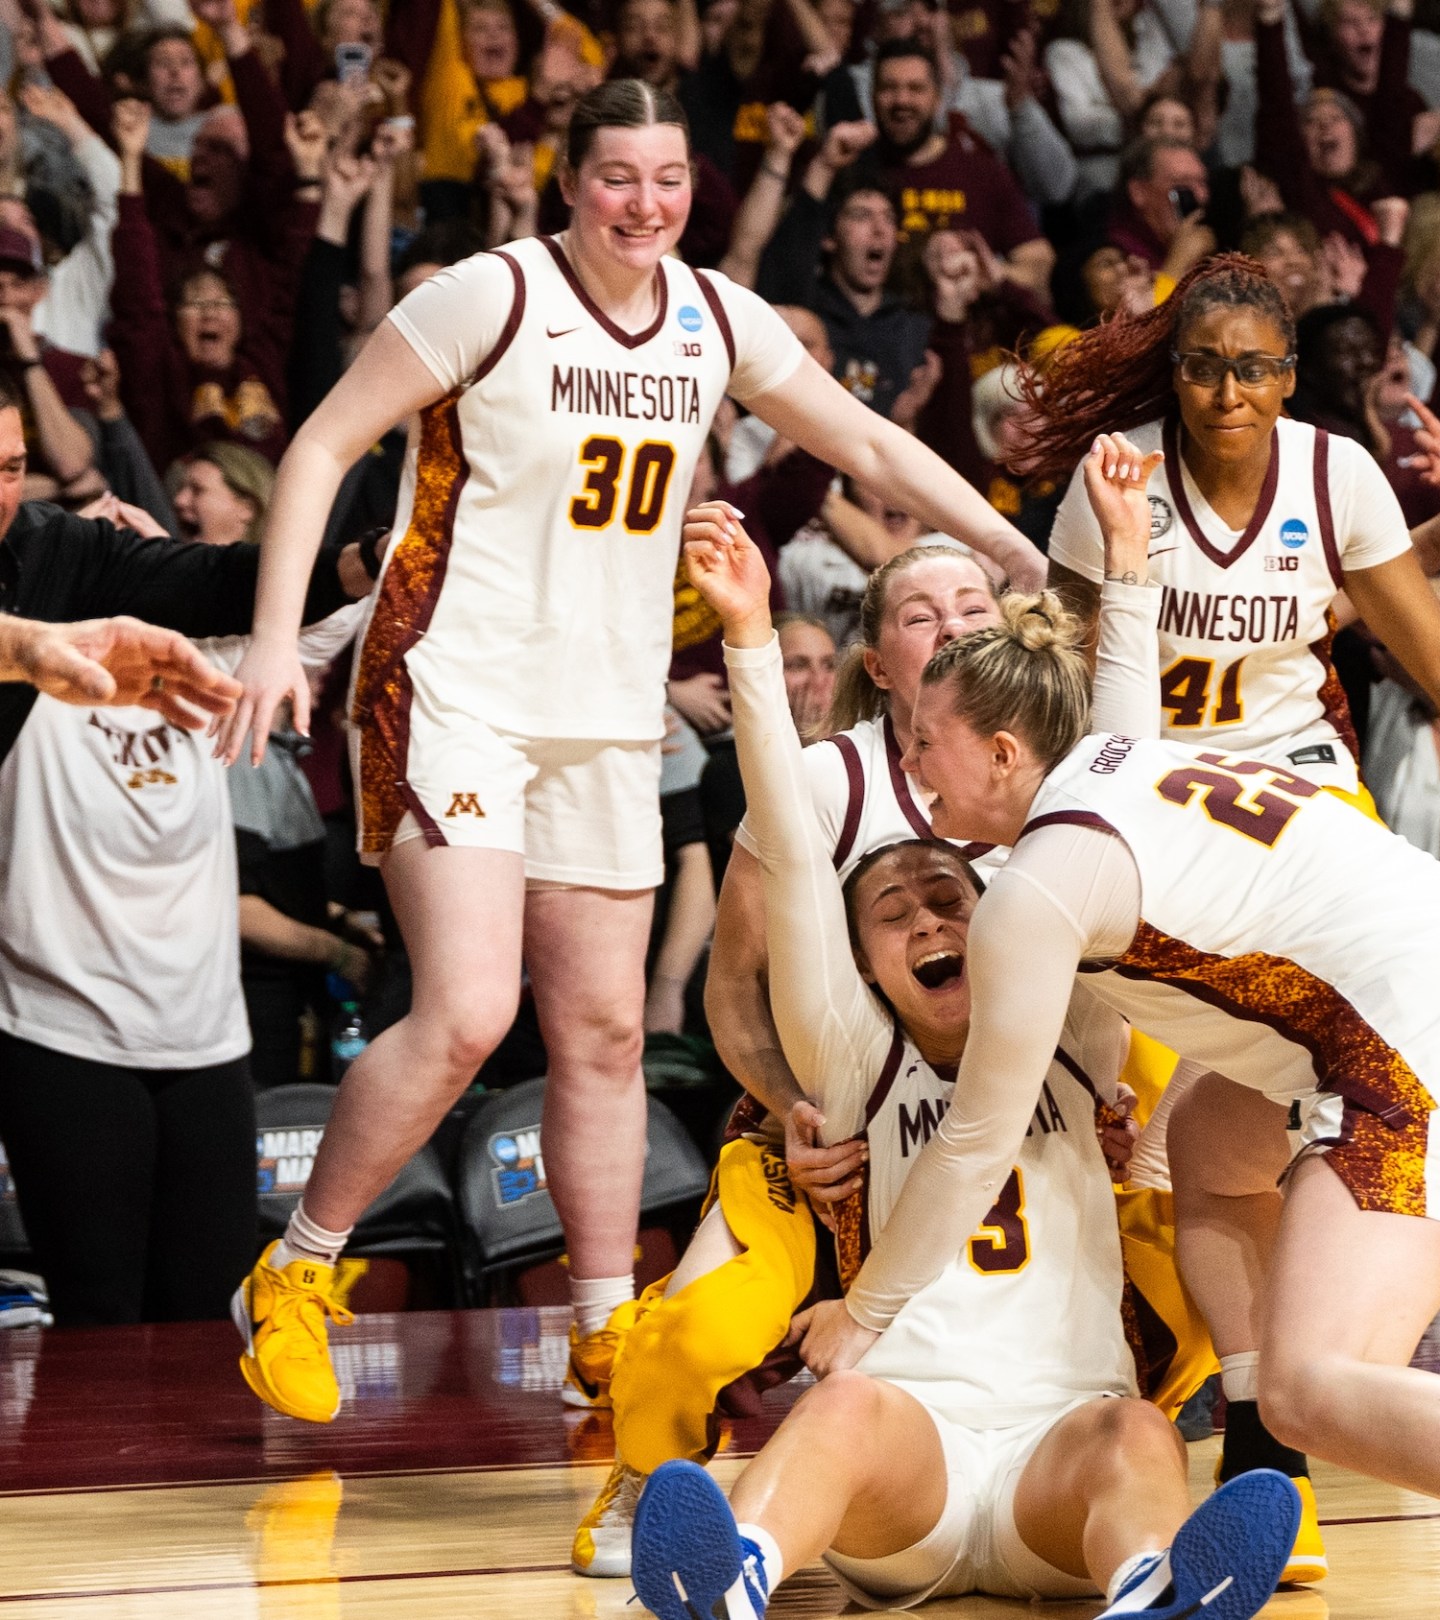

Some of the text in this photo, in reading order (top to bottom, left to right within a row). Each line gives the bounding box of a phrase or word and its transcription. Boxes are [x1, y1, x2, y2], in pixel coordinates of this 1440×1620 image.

[551, 364, 700, 424] MINNESOTA
[567, 433, 677, 536] 30
[1157, 585, 1298, 643] INNESOTA
[1160, 655, 1249, 728] 41
[444, 793, 486, 818] M
